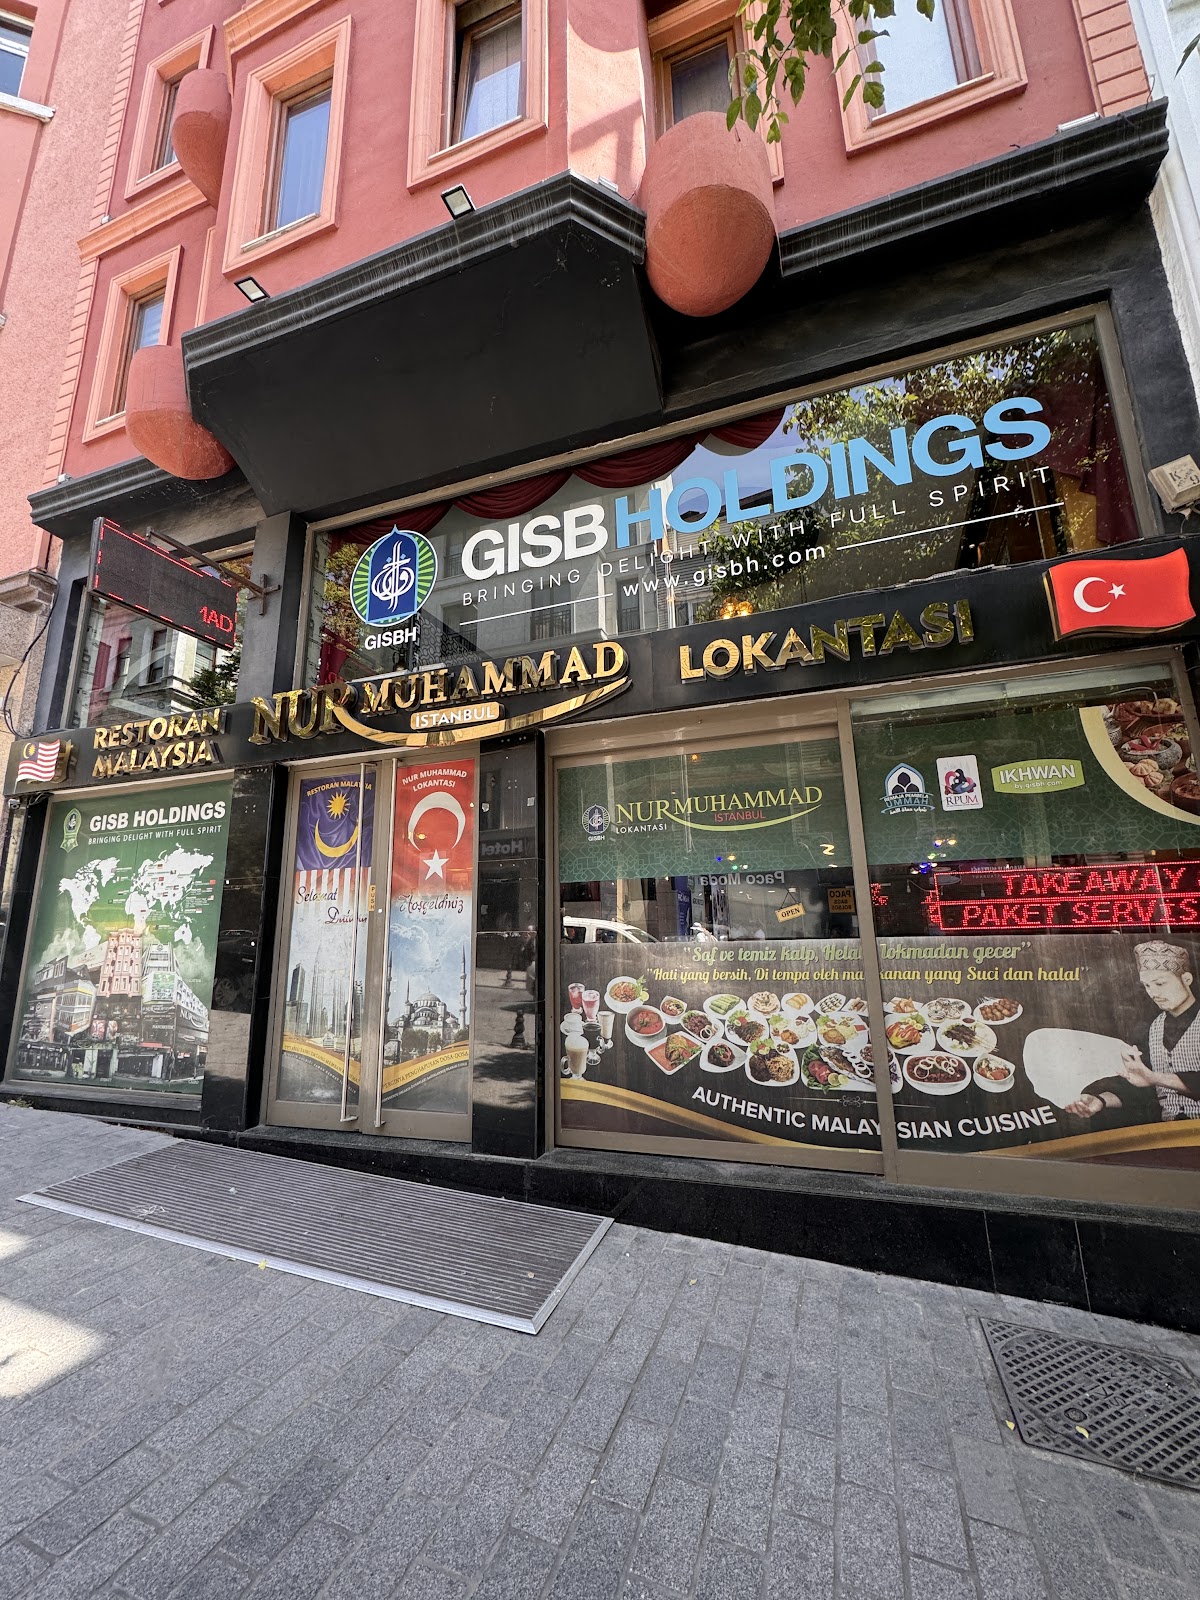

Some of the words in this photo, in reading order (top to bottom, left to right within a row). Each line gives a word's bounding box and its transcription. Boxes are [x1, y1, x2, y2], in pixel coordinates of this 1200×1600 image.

[462, 569, 581, 606] BRINGING
[600, 541, 713, 577] DELIGHT
[731, 522, 804, 549] WITH
[830, 499, 906, 528] FULL
[929, 466, 1050, 508] SPIRIT
[622, 545, 826, 597] www.gisbh.com
[364, 626, 418, 650] GISBH
[679, 599, 974, 680] LOKANTASI
[248, 680, 350, 746] NUR
[360, 641, 628, 716] MUHAMMAD
[93, 707, 221, 750] RESTORAN
[92, 738, 215, 777] MALAYSIA
[401, 773, 419, 785] NUR
[419, 768, 467, 778] MUHAMMAD
[999, 764, 1076, 784] IKHWAN
[306, 781, 340, 797] RESTORAN
[340, 781, 372, 790] MALAYIA
[412, 779, 456, 792] LOKANTASI
[885, 797, 929, 807] UMMAH
[945, 794, 979, 806] RPUM
[89, 812, 129, 832] GISB
[132, 801, 226, 828] HOLDINGS
[88, 834, 121, 846] BRINGING
[123, 832, 152, 842] DELIGHT
[155, 830, 173, 839] WITH
[176, 828, 194, 837] FULL
[197, 825, 222, 835] SPIRIT
[615, 824, 667, 835] LOKANTASI
[1002, 867, 1187, 896] TAKEAWAY
[781, 908, 800, 918] OPEN
[962, 902, 1062, 926] PAKET
[719, 950, 734, 961] ve
[738, 946, 776, 962] temiz
[780, 944, 819, 965] kalp,
[680, 969, 710, 984] yang
[713, 967, 751, 982] bersih,
[754, 967, 768, 980] Di
[772, 969, 810, 984] tempa
[813, 968, 840, 980] oleh
[924, 969, 962, 984] yang
[967, 966, 999, 981] Suci
[1003, 967, 1034, 981] dan
[691, 1086, 806, 1129] AUTHENTIC
[957, 1105, 1058, 1138] CUISINE
